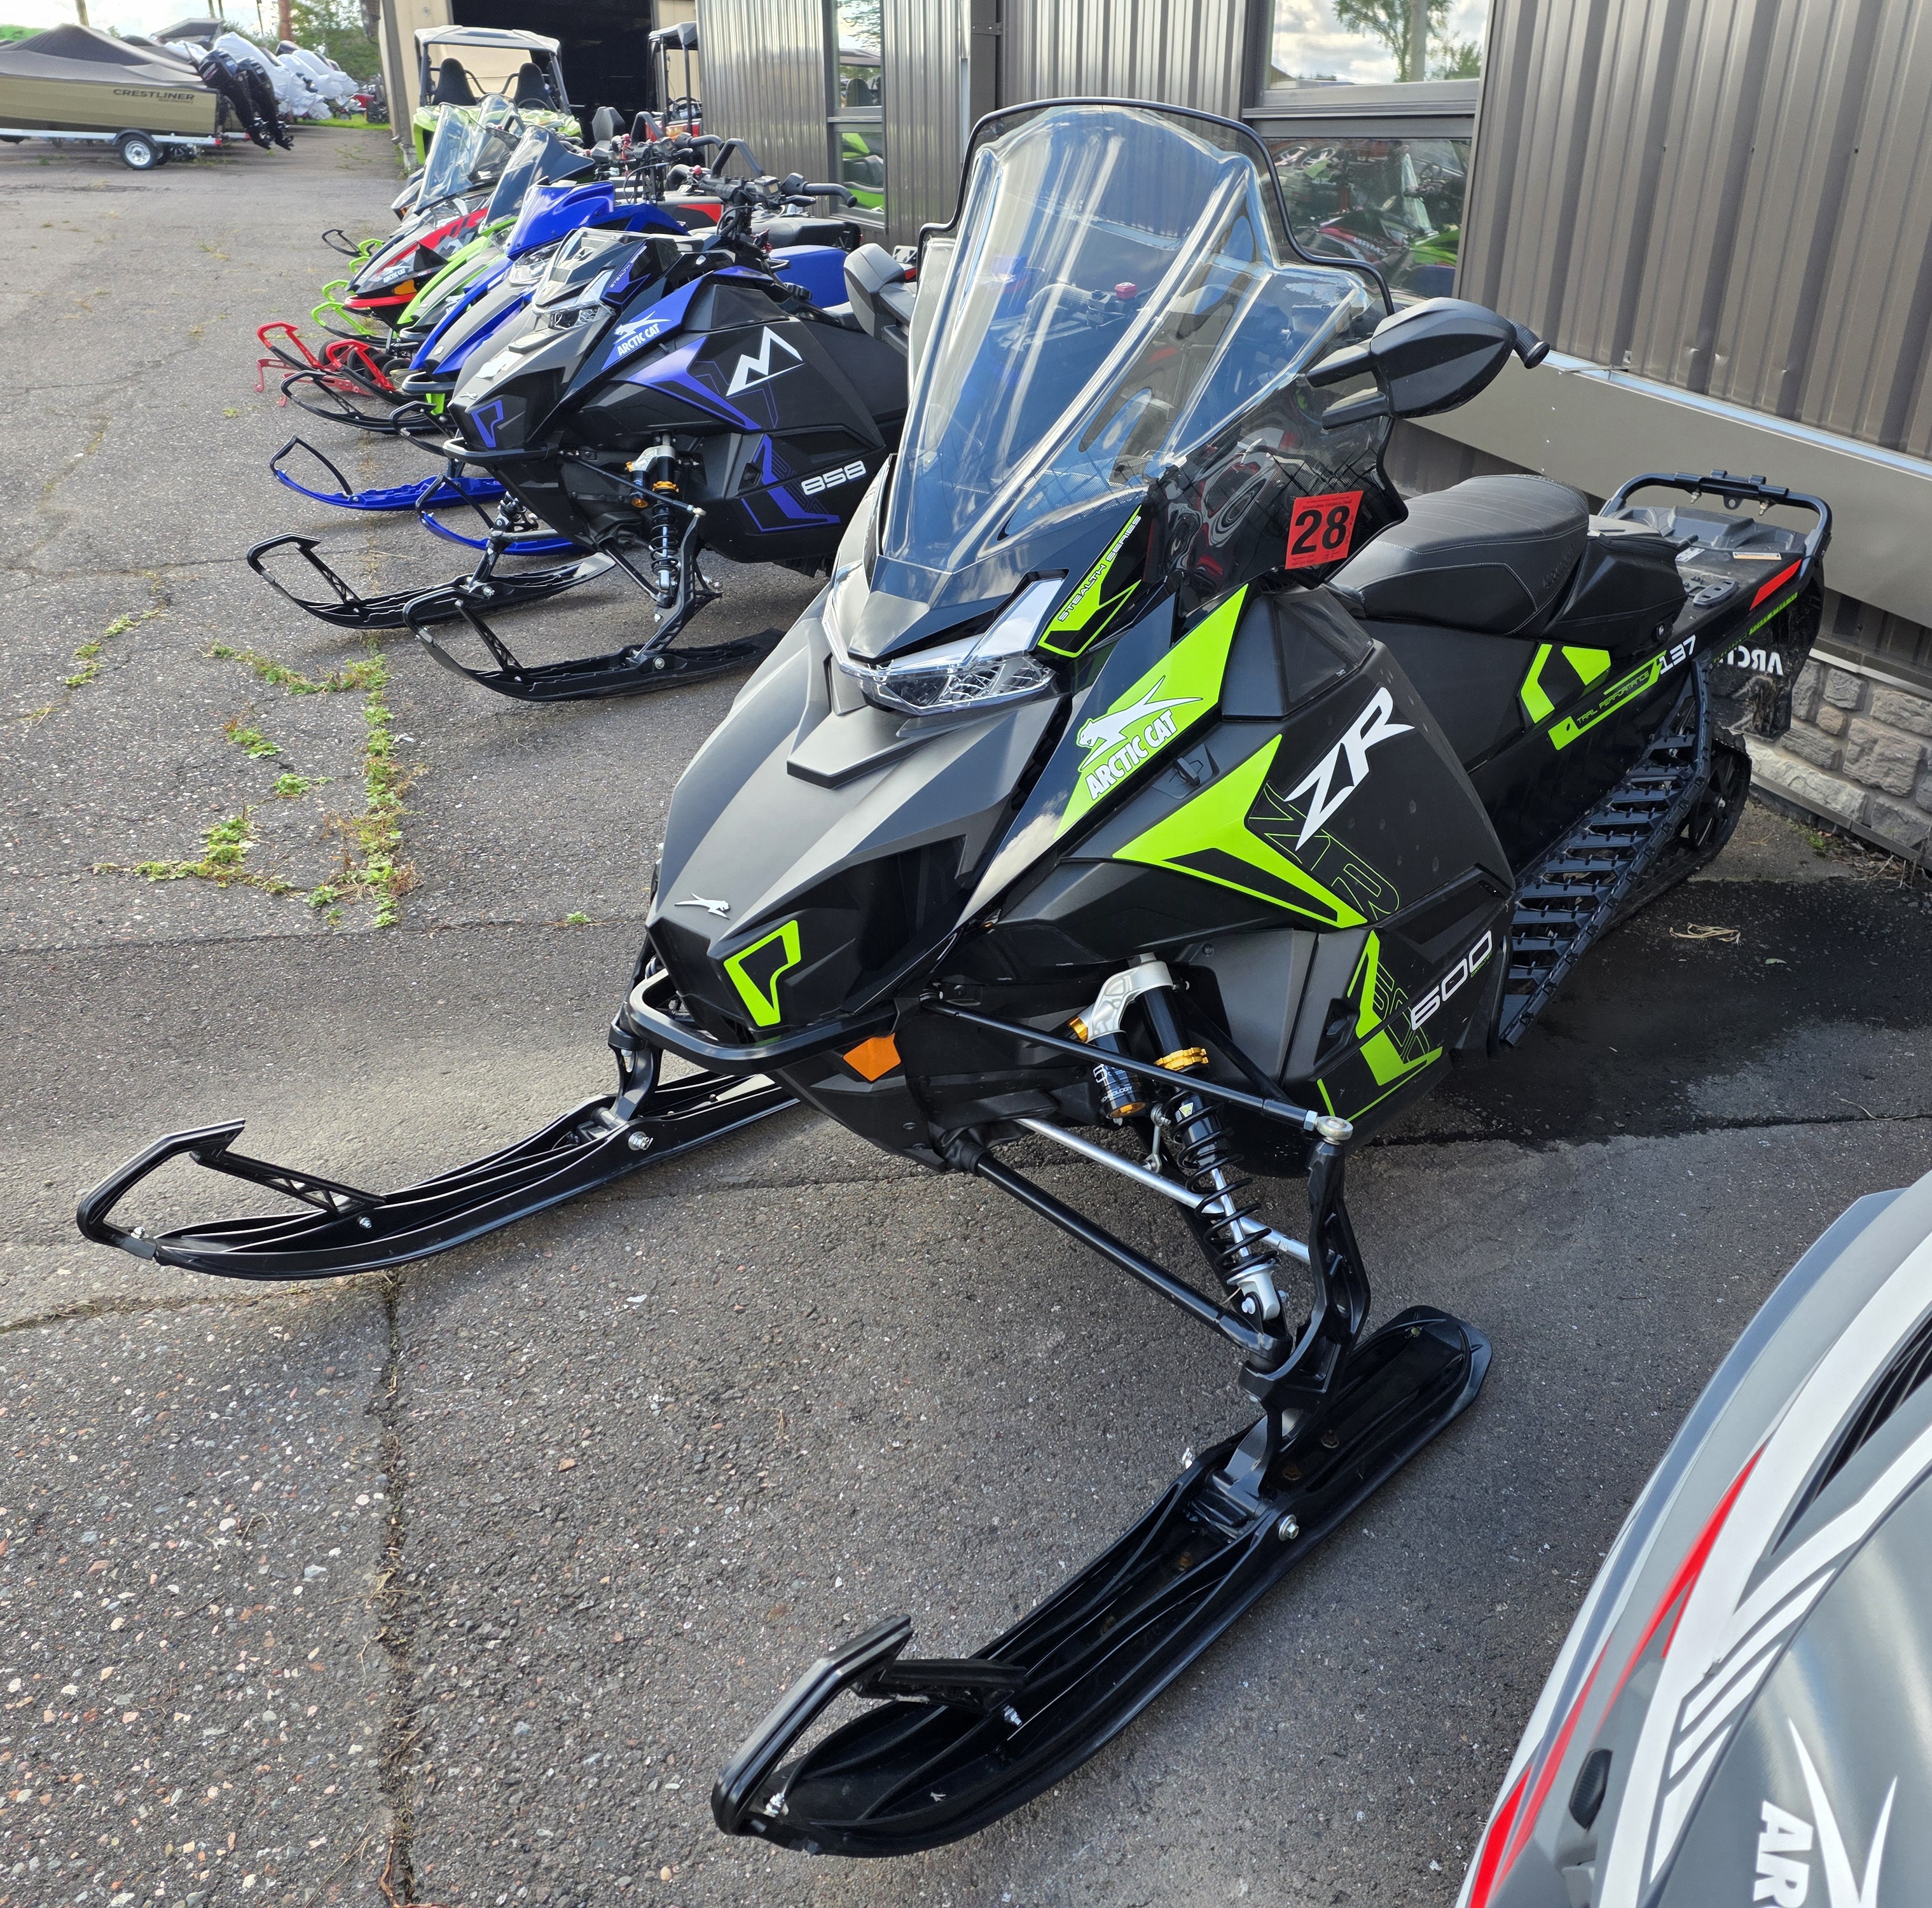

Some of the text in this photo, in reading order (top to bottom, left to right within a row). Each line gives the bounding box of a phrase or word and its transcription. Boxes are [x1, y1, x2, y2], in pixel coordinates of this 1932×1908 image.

[113, 88, 195, 100] CRESTLINER
[383, 272, 399, 284] ARCTIC
[617, 323, 661, 356] ARCTIC CAT
[801, 460, 866, 495] 858
[1291, 505, 1350, 555] 28
[1058, 515, 1142, 623] STEALTH SERIES
[1659, 634, 1696, 675] 137
[1577, 670, 1650, 724] TRAIL PERFORMANCE
[1085, 709, 1178, 801] ARCTIC CAT
[1284, 687, 1416, 851] ZR
[1411, 930, 1493, 1031] 600
[1752, 1799, 1814, 1908] AR
